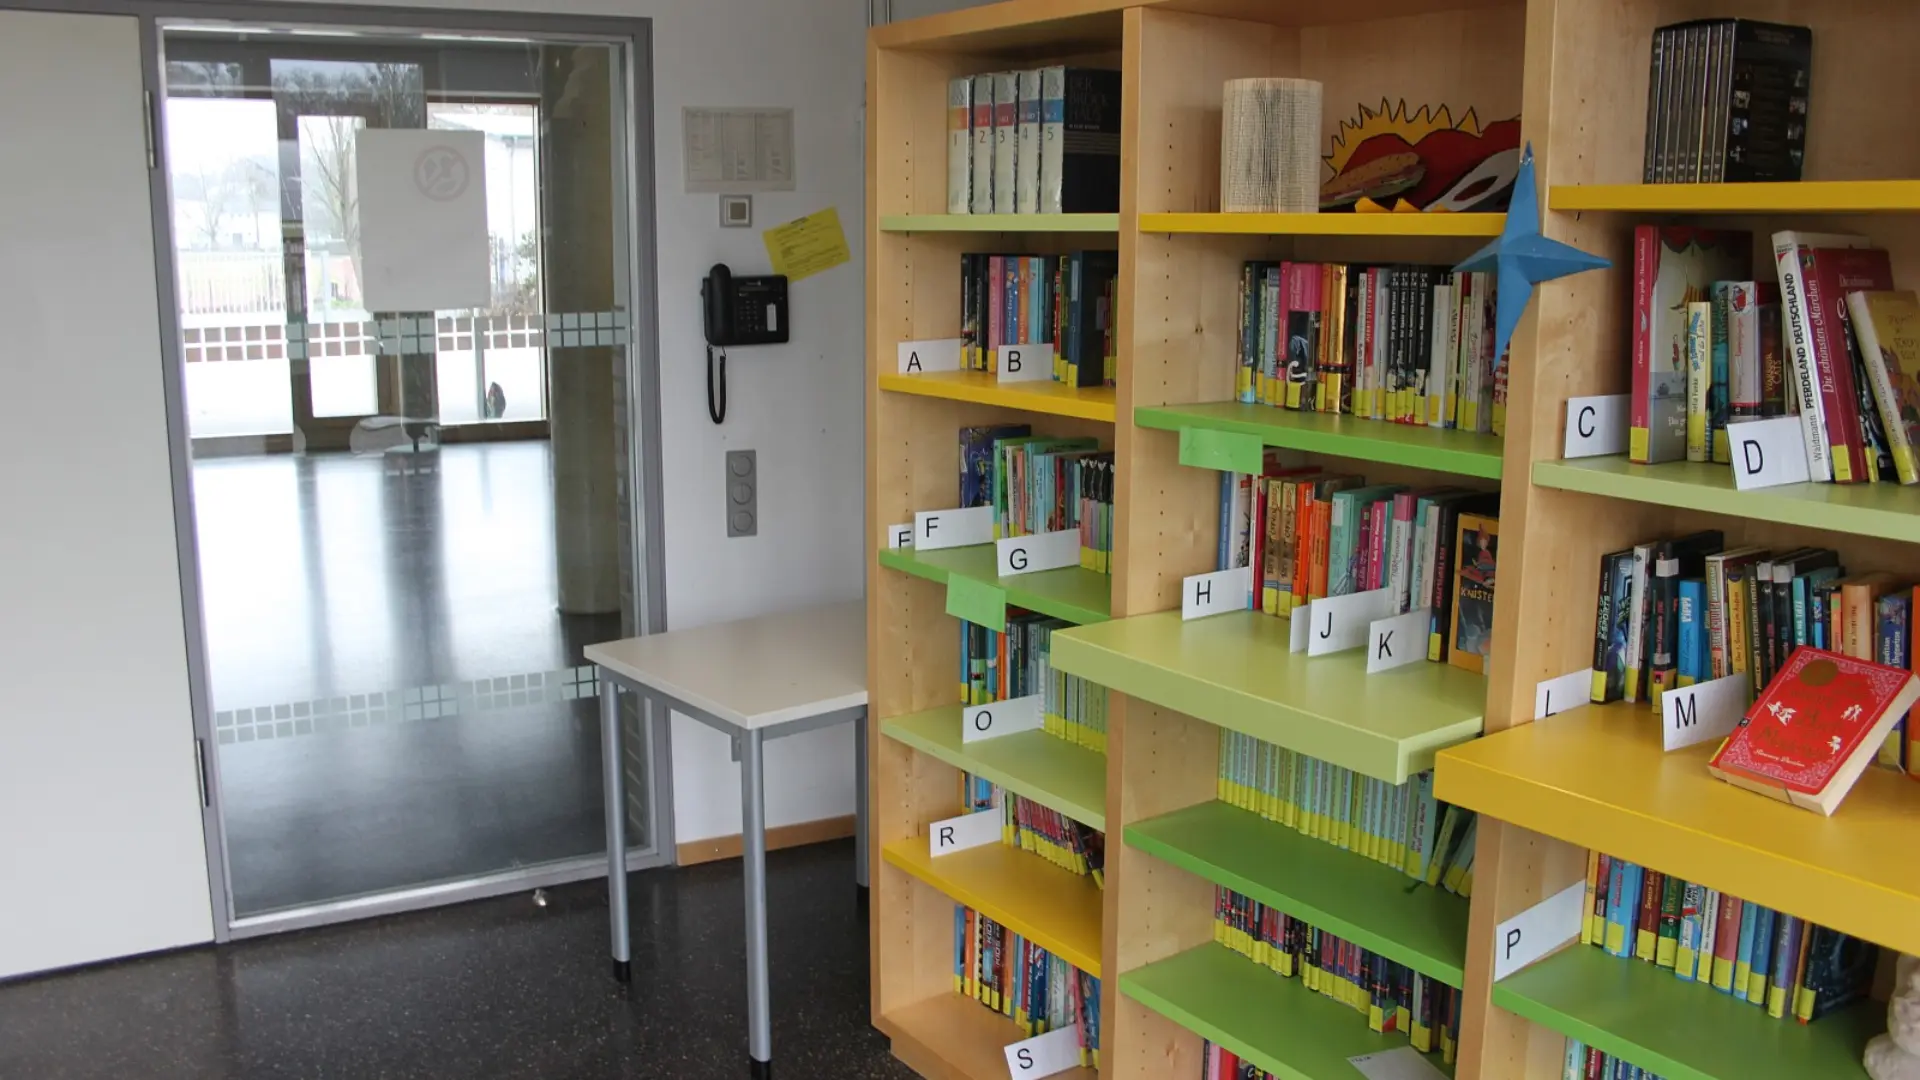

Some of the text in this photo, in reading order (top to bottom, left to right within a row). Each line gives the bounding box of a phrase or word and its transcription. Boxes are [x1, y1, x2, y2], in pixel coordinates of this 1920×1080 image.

[953, 132, 958, 147] 1
[979, 129, 987, 144] 2
[999, 128, 1006, 144] 3
[1021, 126, 1029, 141] 4
[1046, 126, 1054, 141] 5
[1784, 272, 1815, 410] PFERDELAND DEUTSCHLAND
[1806, 278, 1835, 393] Die schönsten Märchen
[907, 352, 922, 372] A
[1008, 351, 1022, 373] B
[1773, 359, 1783, 386] CATS
[1579, 405, 1596, 439] C
[1807, 414, 1822, 462] Waldmann
[1743, 439, 1764, 475] D
[926, 516, 940, 538] F
[1009, 548, 1028, 571] G
[1196, 579, 1211, 606] H
[1460, 584, 1494, 603] KNISTE
[1320, 611, 1333, 639] J
[1378, 630, 1393, 660] K
[1544, 689, 1557, 718] L
[1674, 692, 1697, 730] M
[975, 710, 993, 731] O
[940, 826, 955, 847] R
[1506, 928, 1522, 960] P
[1016, 1047, 1034, 1070] S
